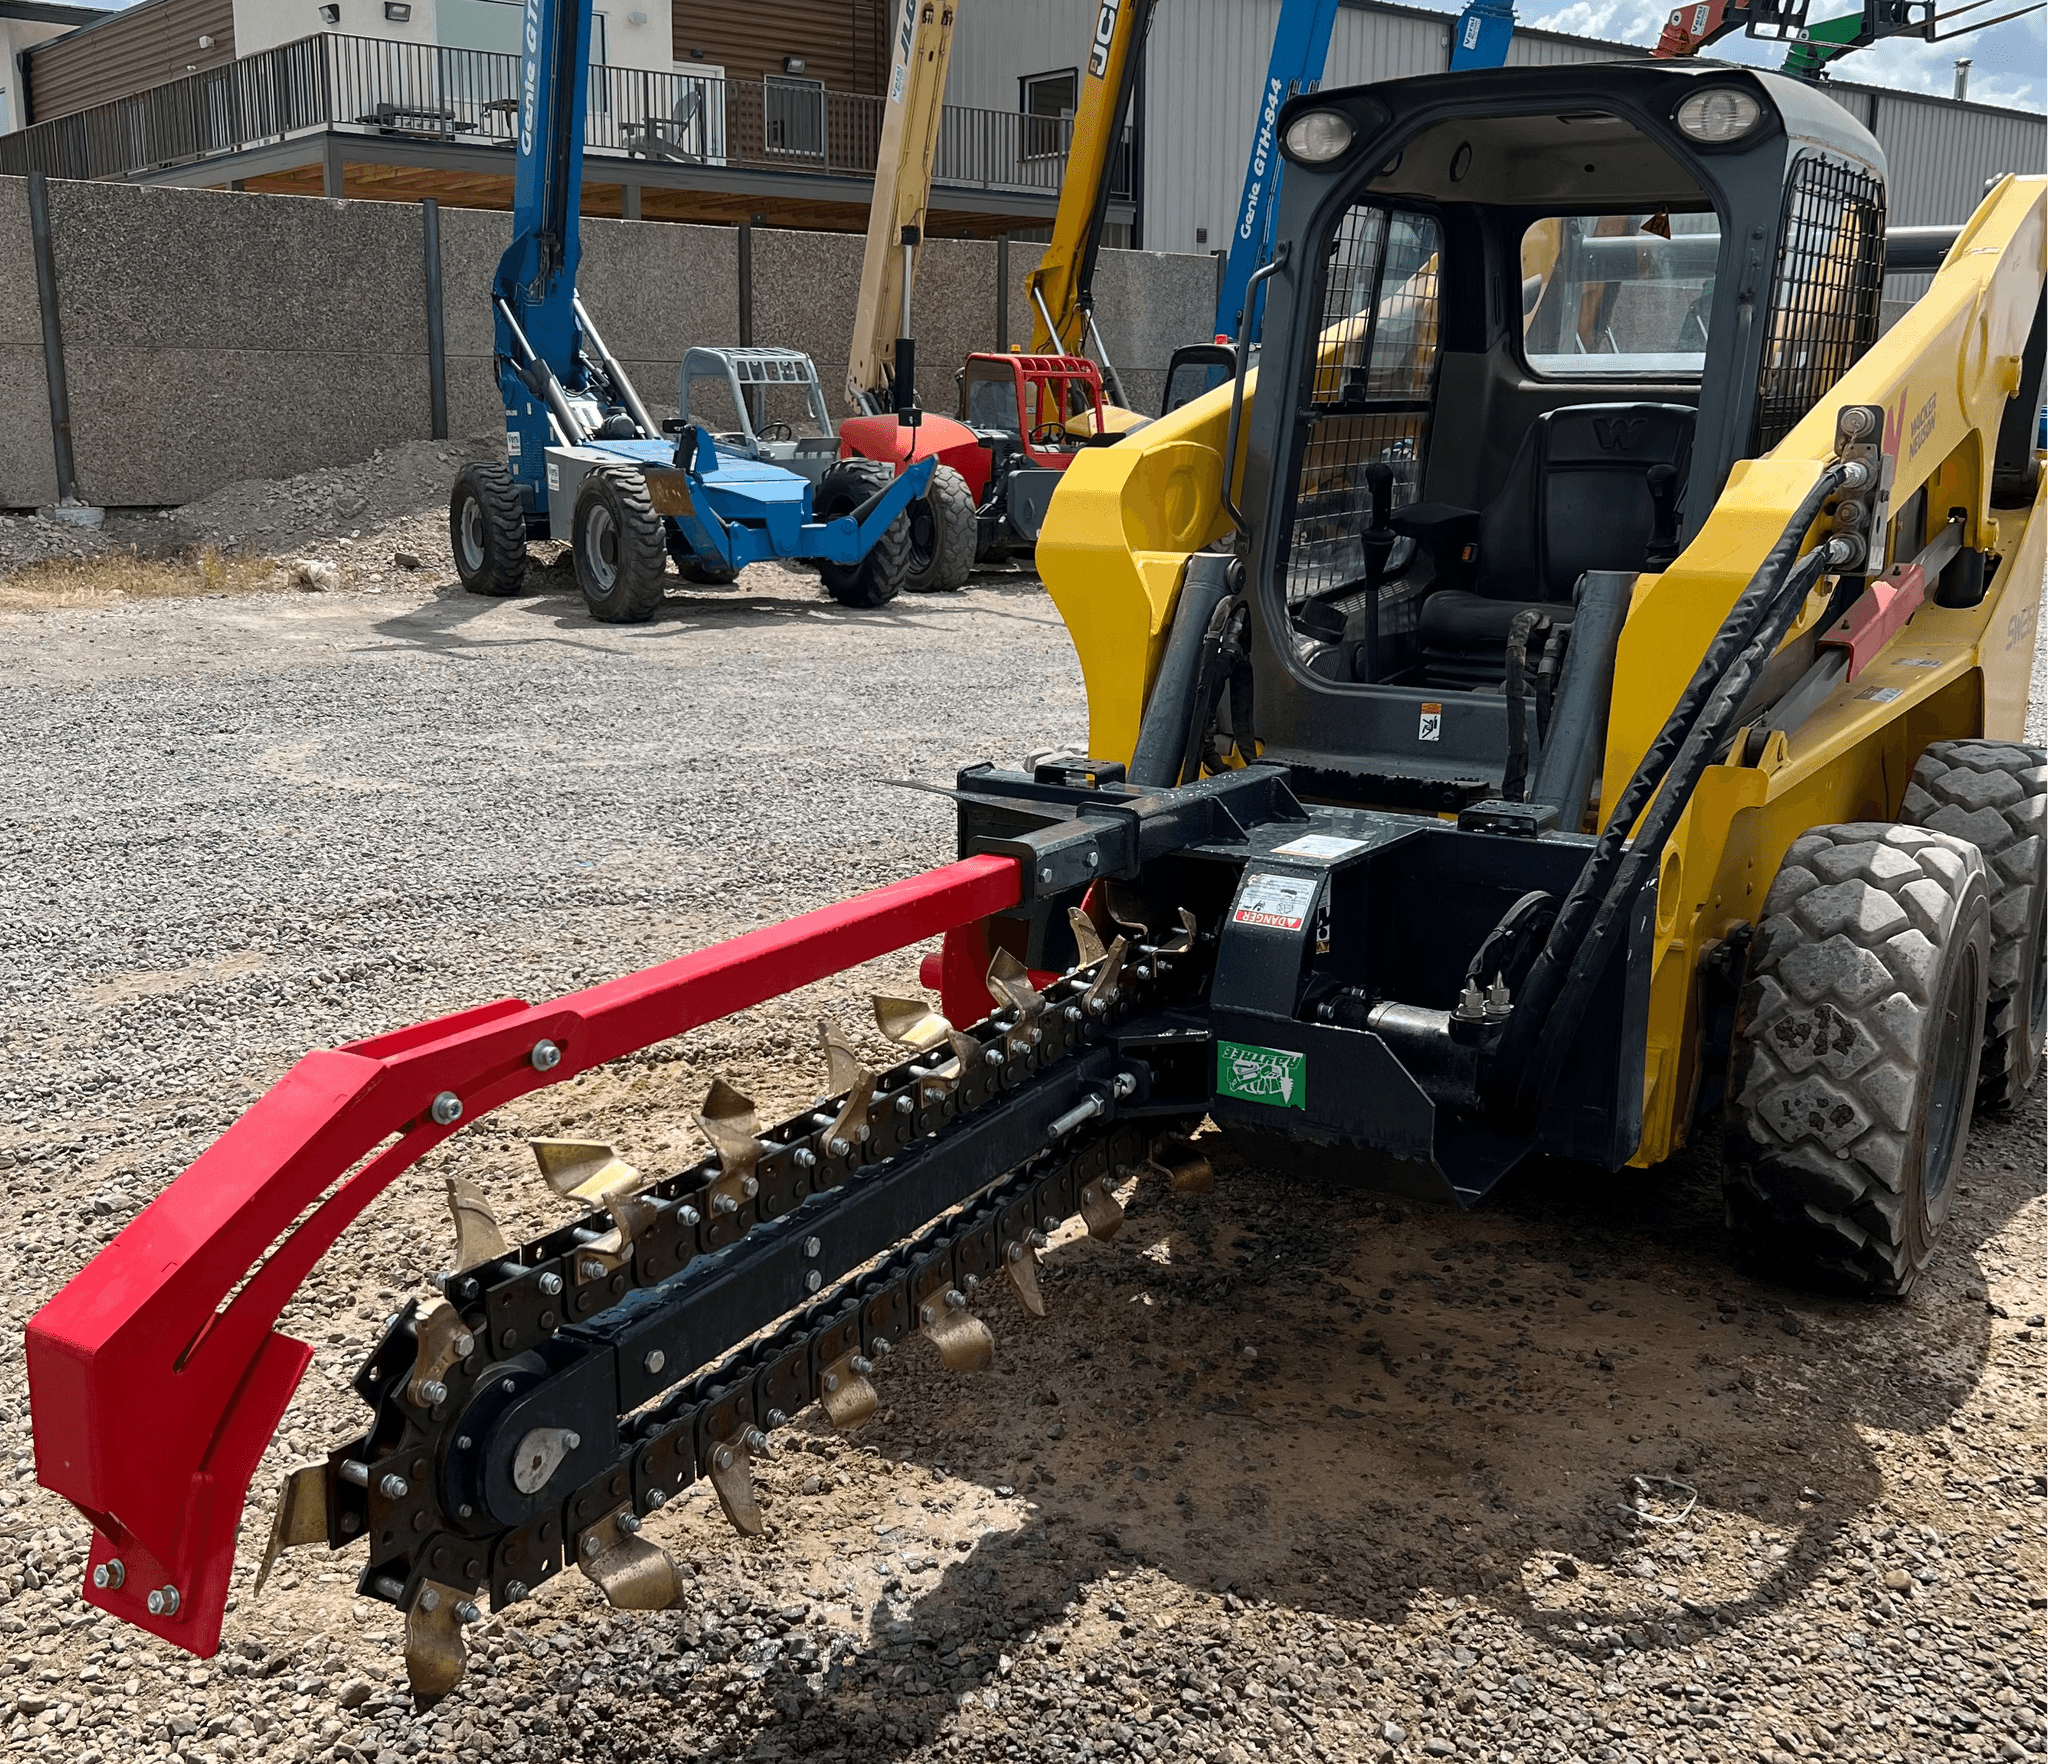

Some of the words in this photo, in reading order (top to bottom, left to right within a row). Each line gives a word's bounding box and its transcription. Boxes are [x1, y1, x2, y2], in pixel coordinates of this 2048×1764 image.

[526, 0, 539, 53] GT
[1092, 0, 1120, 76] JC
[522, 60, 536, 156] Genie
[1240, 181, 1261, 239] Genie
[1254, 77, 1282, 177] GTH-844
[1241, 910, 1287, 927] DANGER
